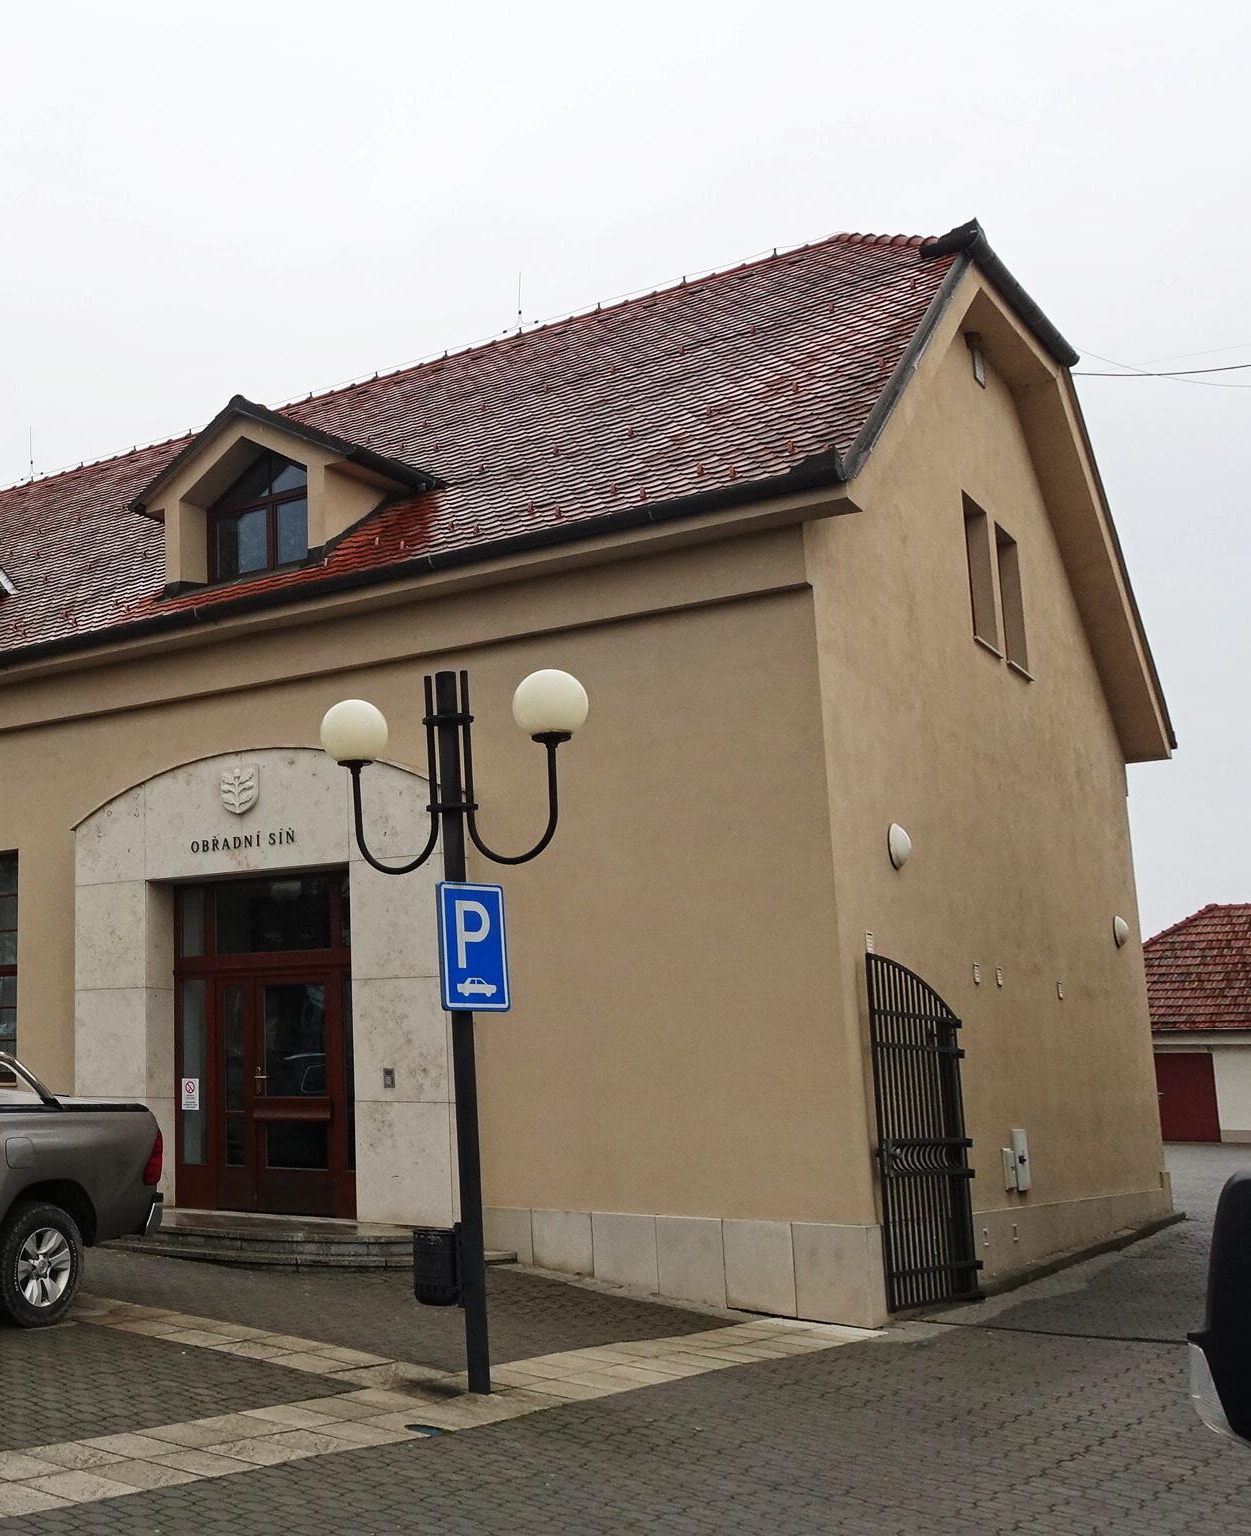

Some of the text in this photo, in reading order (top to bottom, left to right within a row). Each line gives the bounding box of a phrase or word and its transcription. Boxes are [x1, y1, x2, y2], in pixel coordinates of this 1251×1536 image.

[190, 827, 296, 853] OBŘADNÍ SÍŇ
[455, 899, 491, 969] P
